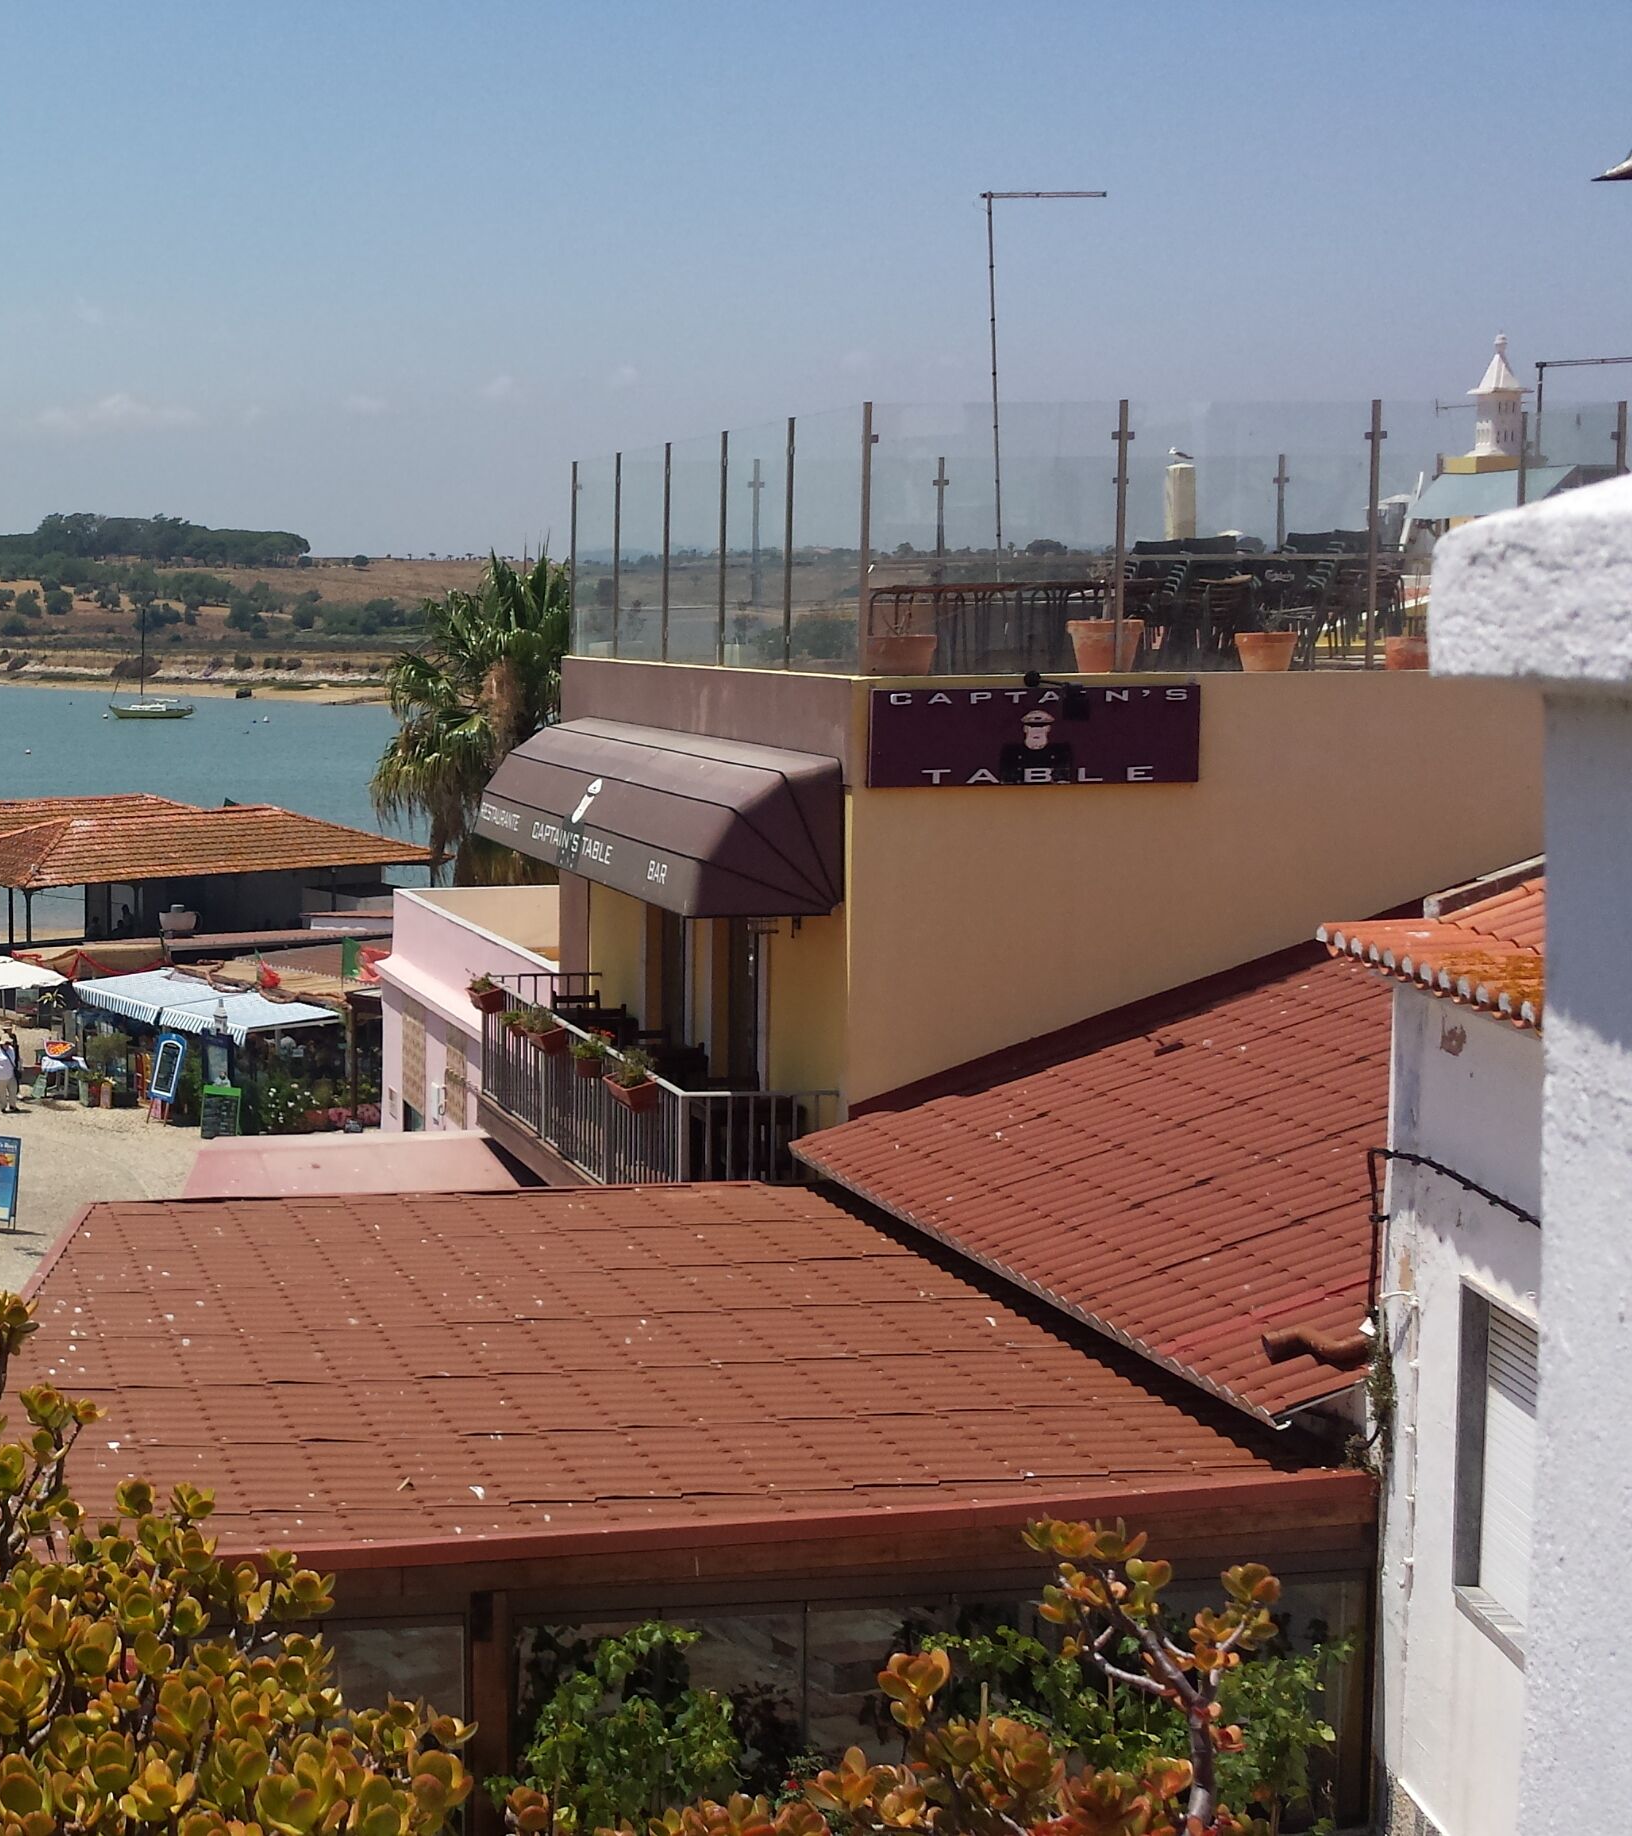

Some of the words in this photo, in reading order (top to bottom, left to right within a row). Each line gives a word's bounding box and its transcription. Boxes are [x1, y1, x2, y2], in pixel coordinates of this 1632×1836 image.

[889, 687, 1188, 706] CAPTAN'S
[921, 766, 1154, 785] TABLE
[480, 801, 520, 832] RESTAURANTE
[531, 821, 580, 853] CAPTAIN'S
[581, 836, 614, 865] TABLE
[647, 859, 668, 885] BAR
